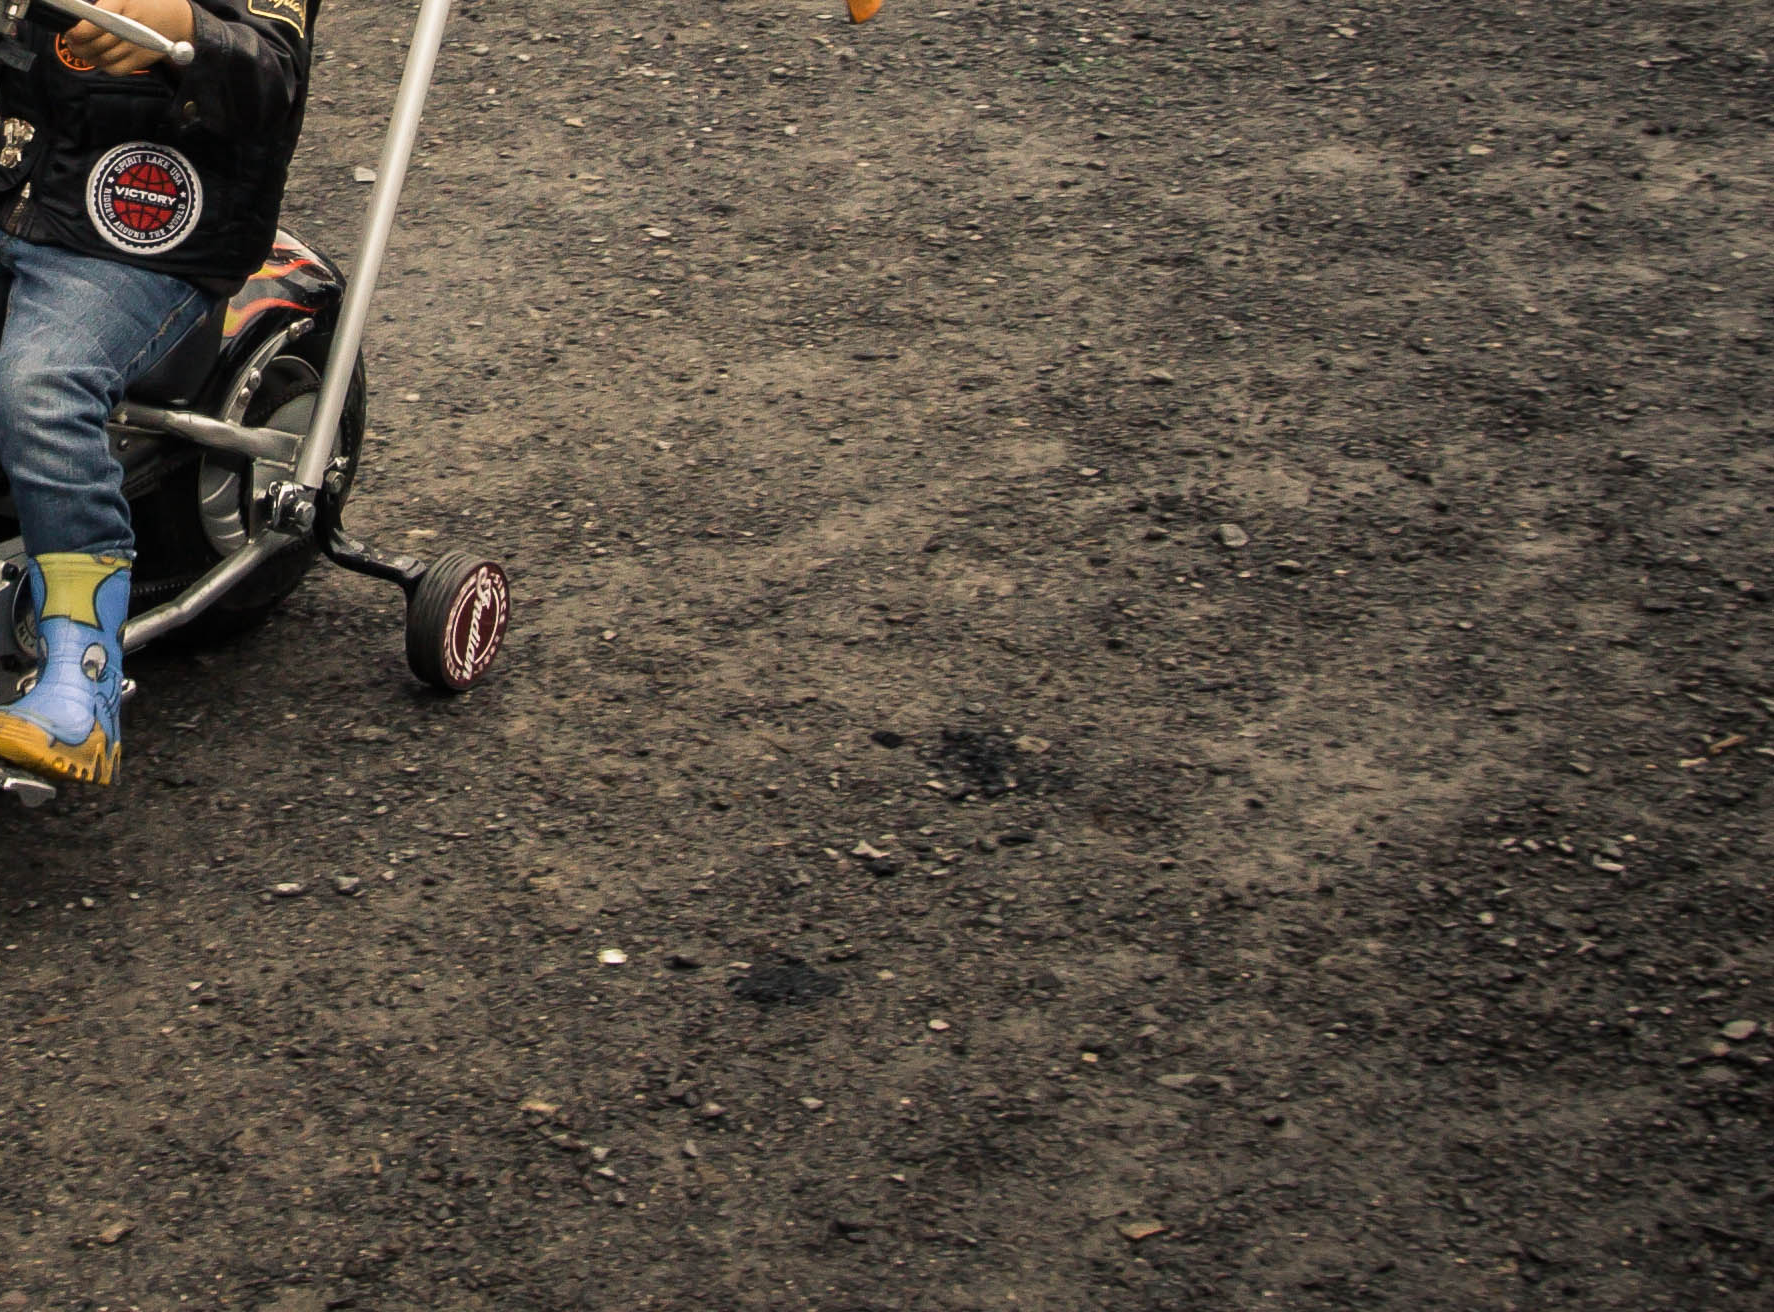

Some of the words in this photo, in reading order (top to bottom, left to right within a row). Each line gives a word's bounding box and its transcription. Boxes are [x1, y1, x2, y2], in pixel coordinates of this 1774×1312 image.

[114, 155, 142, 174] SPIRIT
[145, 154, 171, 170] LAKE
[169, 167, 184, 186] USA
[114, 185, 177, 206] VICTORY
[113, 220, 146, 240] AROUND
[148, 231, 167, 239] THE
[166, 204, 186, 231] WORLD
